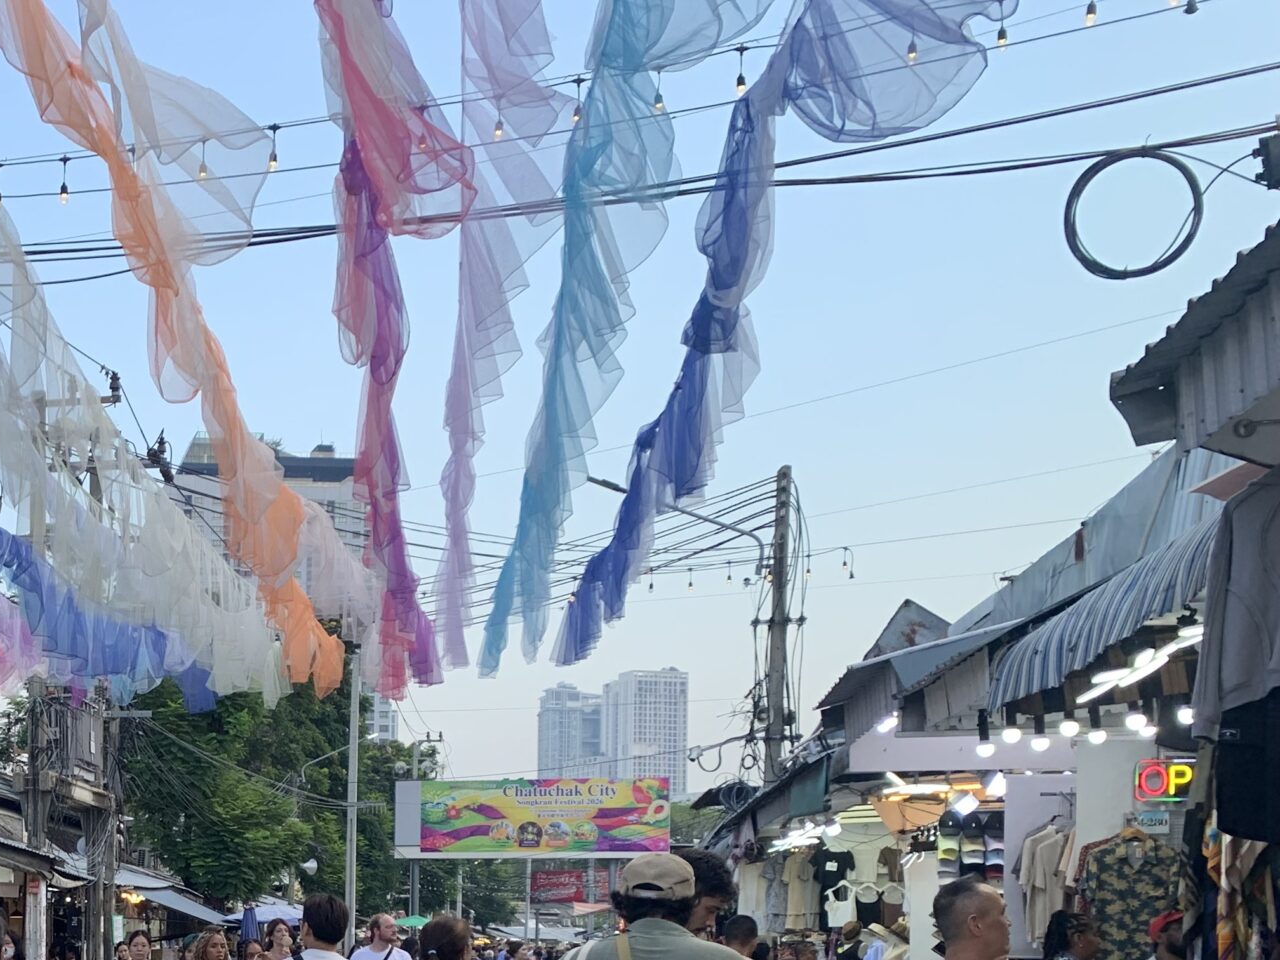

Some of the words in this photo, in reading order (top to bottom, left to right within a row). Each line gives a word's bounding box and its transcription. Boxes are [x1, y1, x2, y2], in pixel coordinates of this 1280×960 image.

[1139, 764, 1193, 796] OP
[503, 784, 583, 797] Chatuchak
[588, 784, 617, 800] City
[517, 799, 552, 807] Songkran
